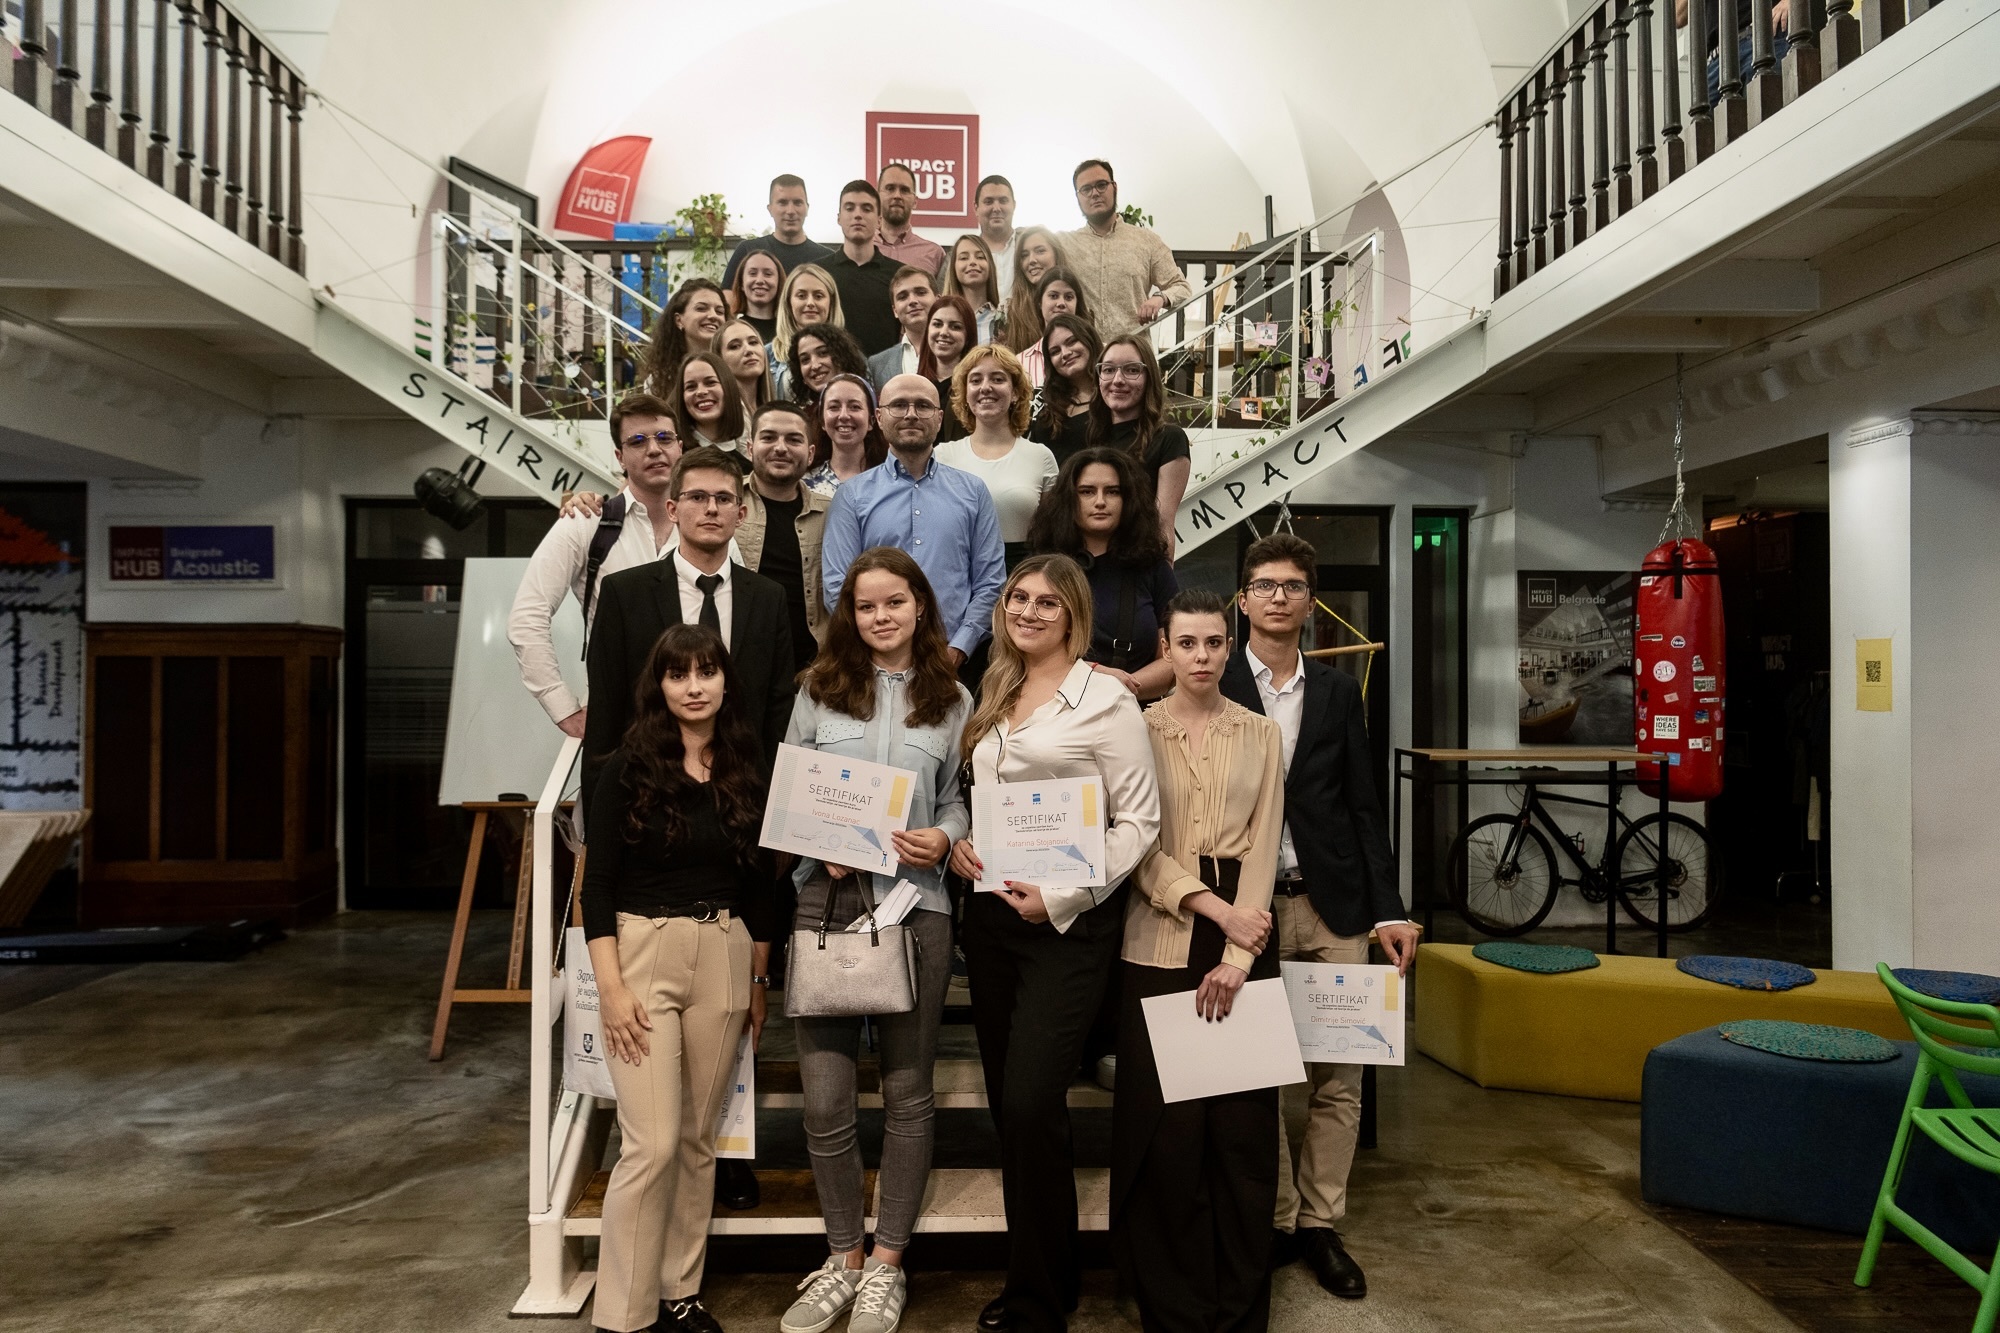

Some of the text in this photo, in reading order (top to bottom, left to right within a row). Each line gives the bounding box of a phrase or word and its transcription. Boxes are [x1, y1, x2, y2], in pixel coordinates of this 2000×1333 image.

[580, 186, 619, 200] IMPACT
[915, 174, 956, 200] UB
[576, 193, 617, 215] HUB
[402, 373, 585, 492] STAIRW
[1174, 416, 1348, 544] IMPACT
[113, 547, 161, 558] IMPACT
[170, 547, 224, 559] Belgrade
[113, 559, 161, 577] HUB
[171, 559, 260, 576] Acoustic
[1531, 594, 1606, 606] HUB Belgrade
[808, 783, 873, 806] SERTIFIKAT
[811, 808, 831, 819] Ivona
[832, 813, 861, 826] Lozanac
[1006, 812, 1067, 827] SERTIFIKAT
[1006, 837, 1070, 848] Katarina Stojanović
[576, 968, 597, 984] Здра
[1307, 993, 1369, 1005] SERTIFIKAT
[1310, 1015, 1367, 1025] Dimitrije Simović
